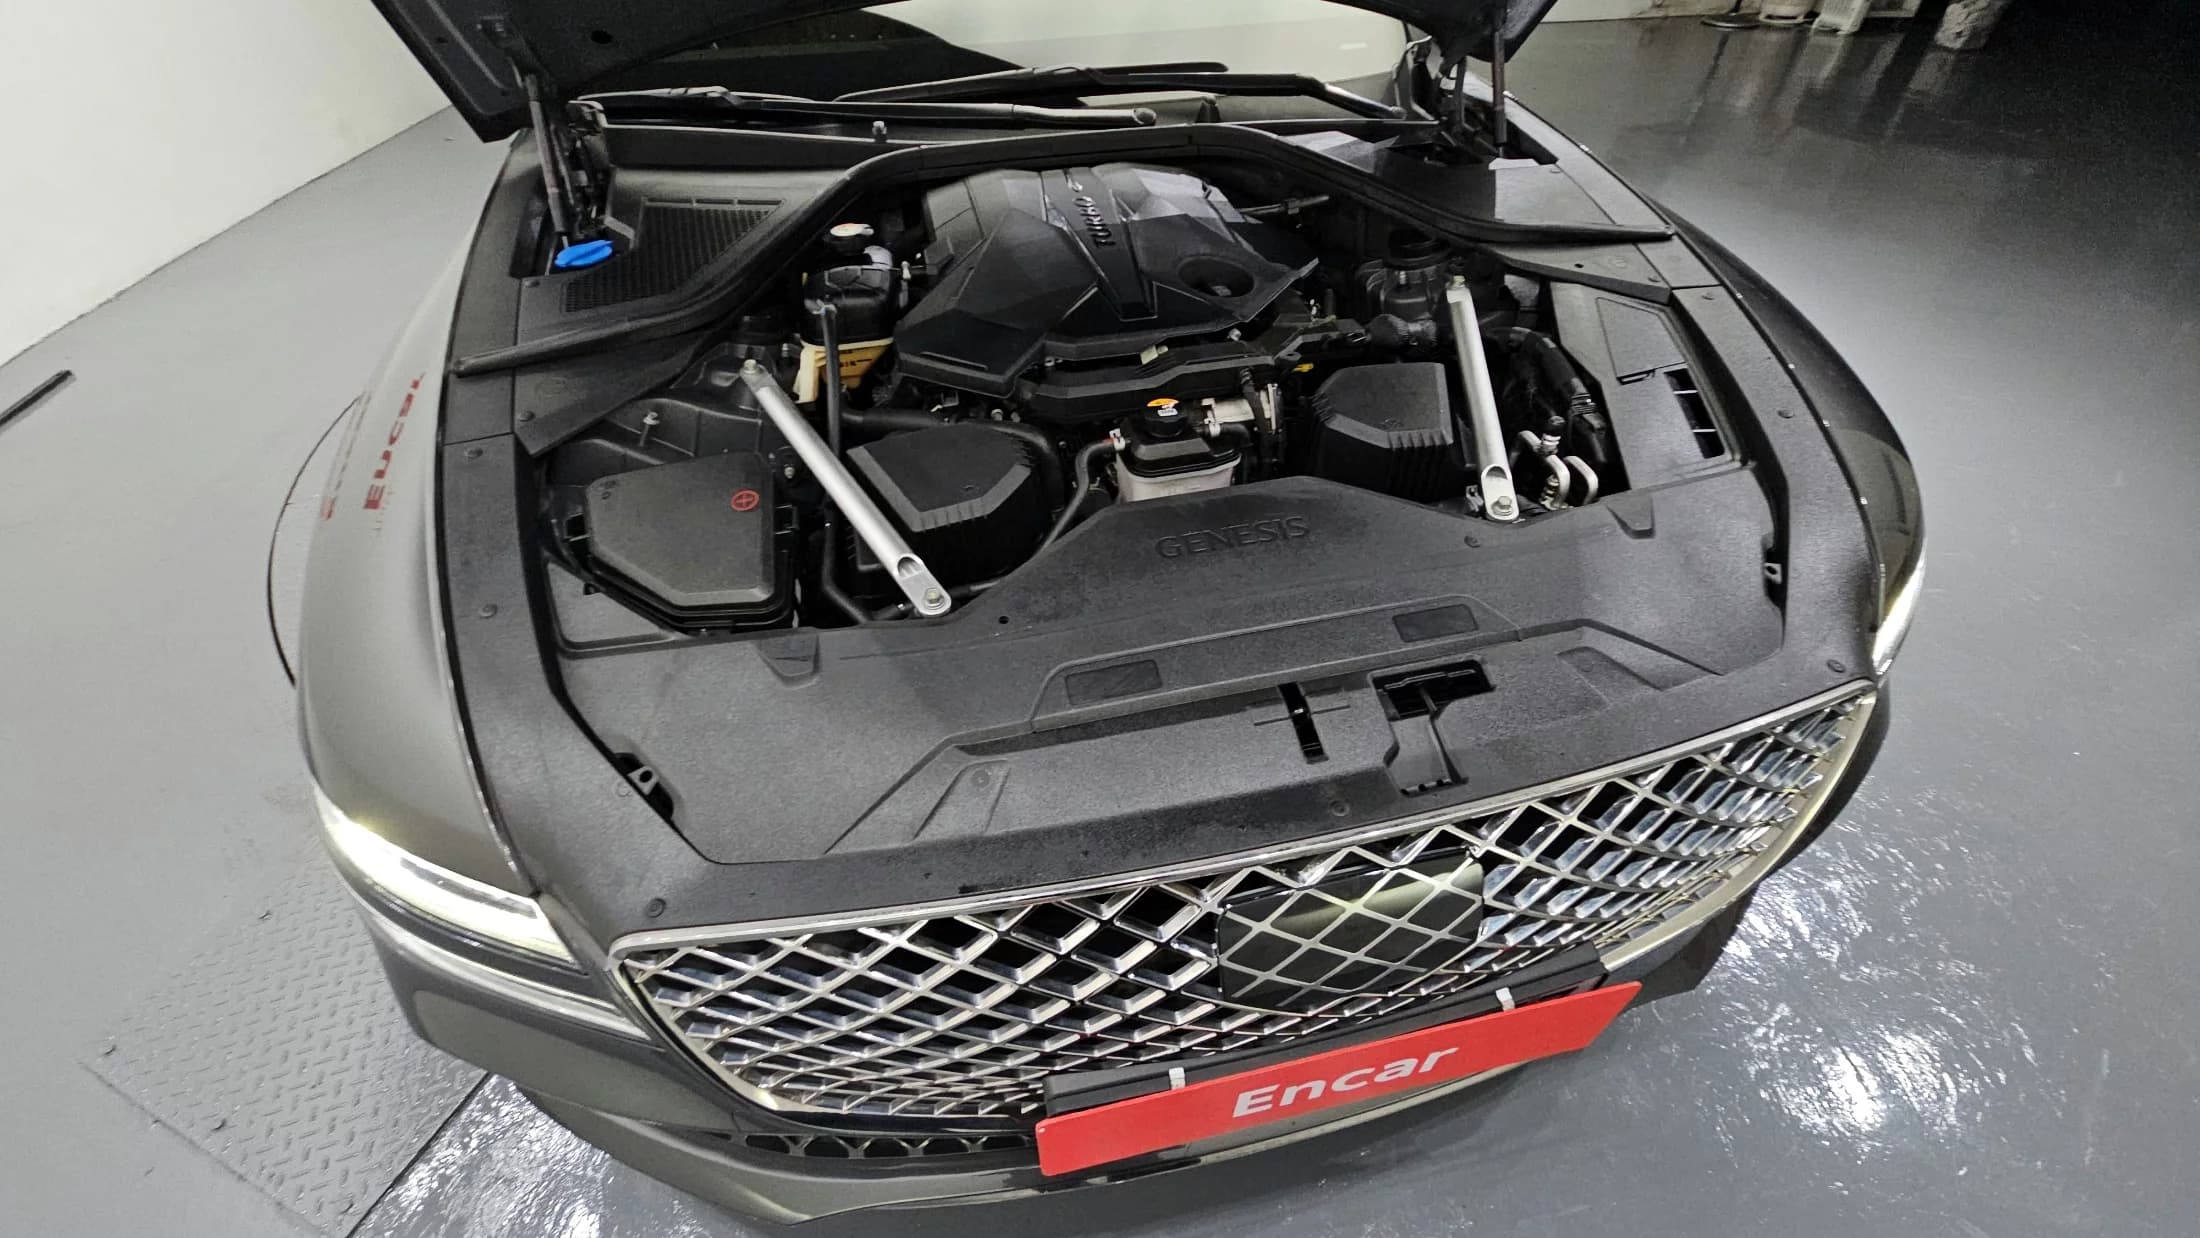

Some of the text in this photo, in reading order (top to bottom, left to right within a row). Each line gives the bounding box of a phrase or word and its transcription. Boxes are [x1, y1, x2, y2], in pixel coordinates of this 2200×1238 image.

[1072, 195, 1117, 248] TURBO
[1155, 515, 1309, 558] GENESIS
[1232, 1047, 1459, 1118] Encar
